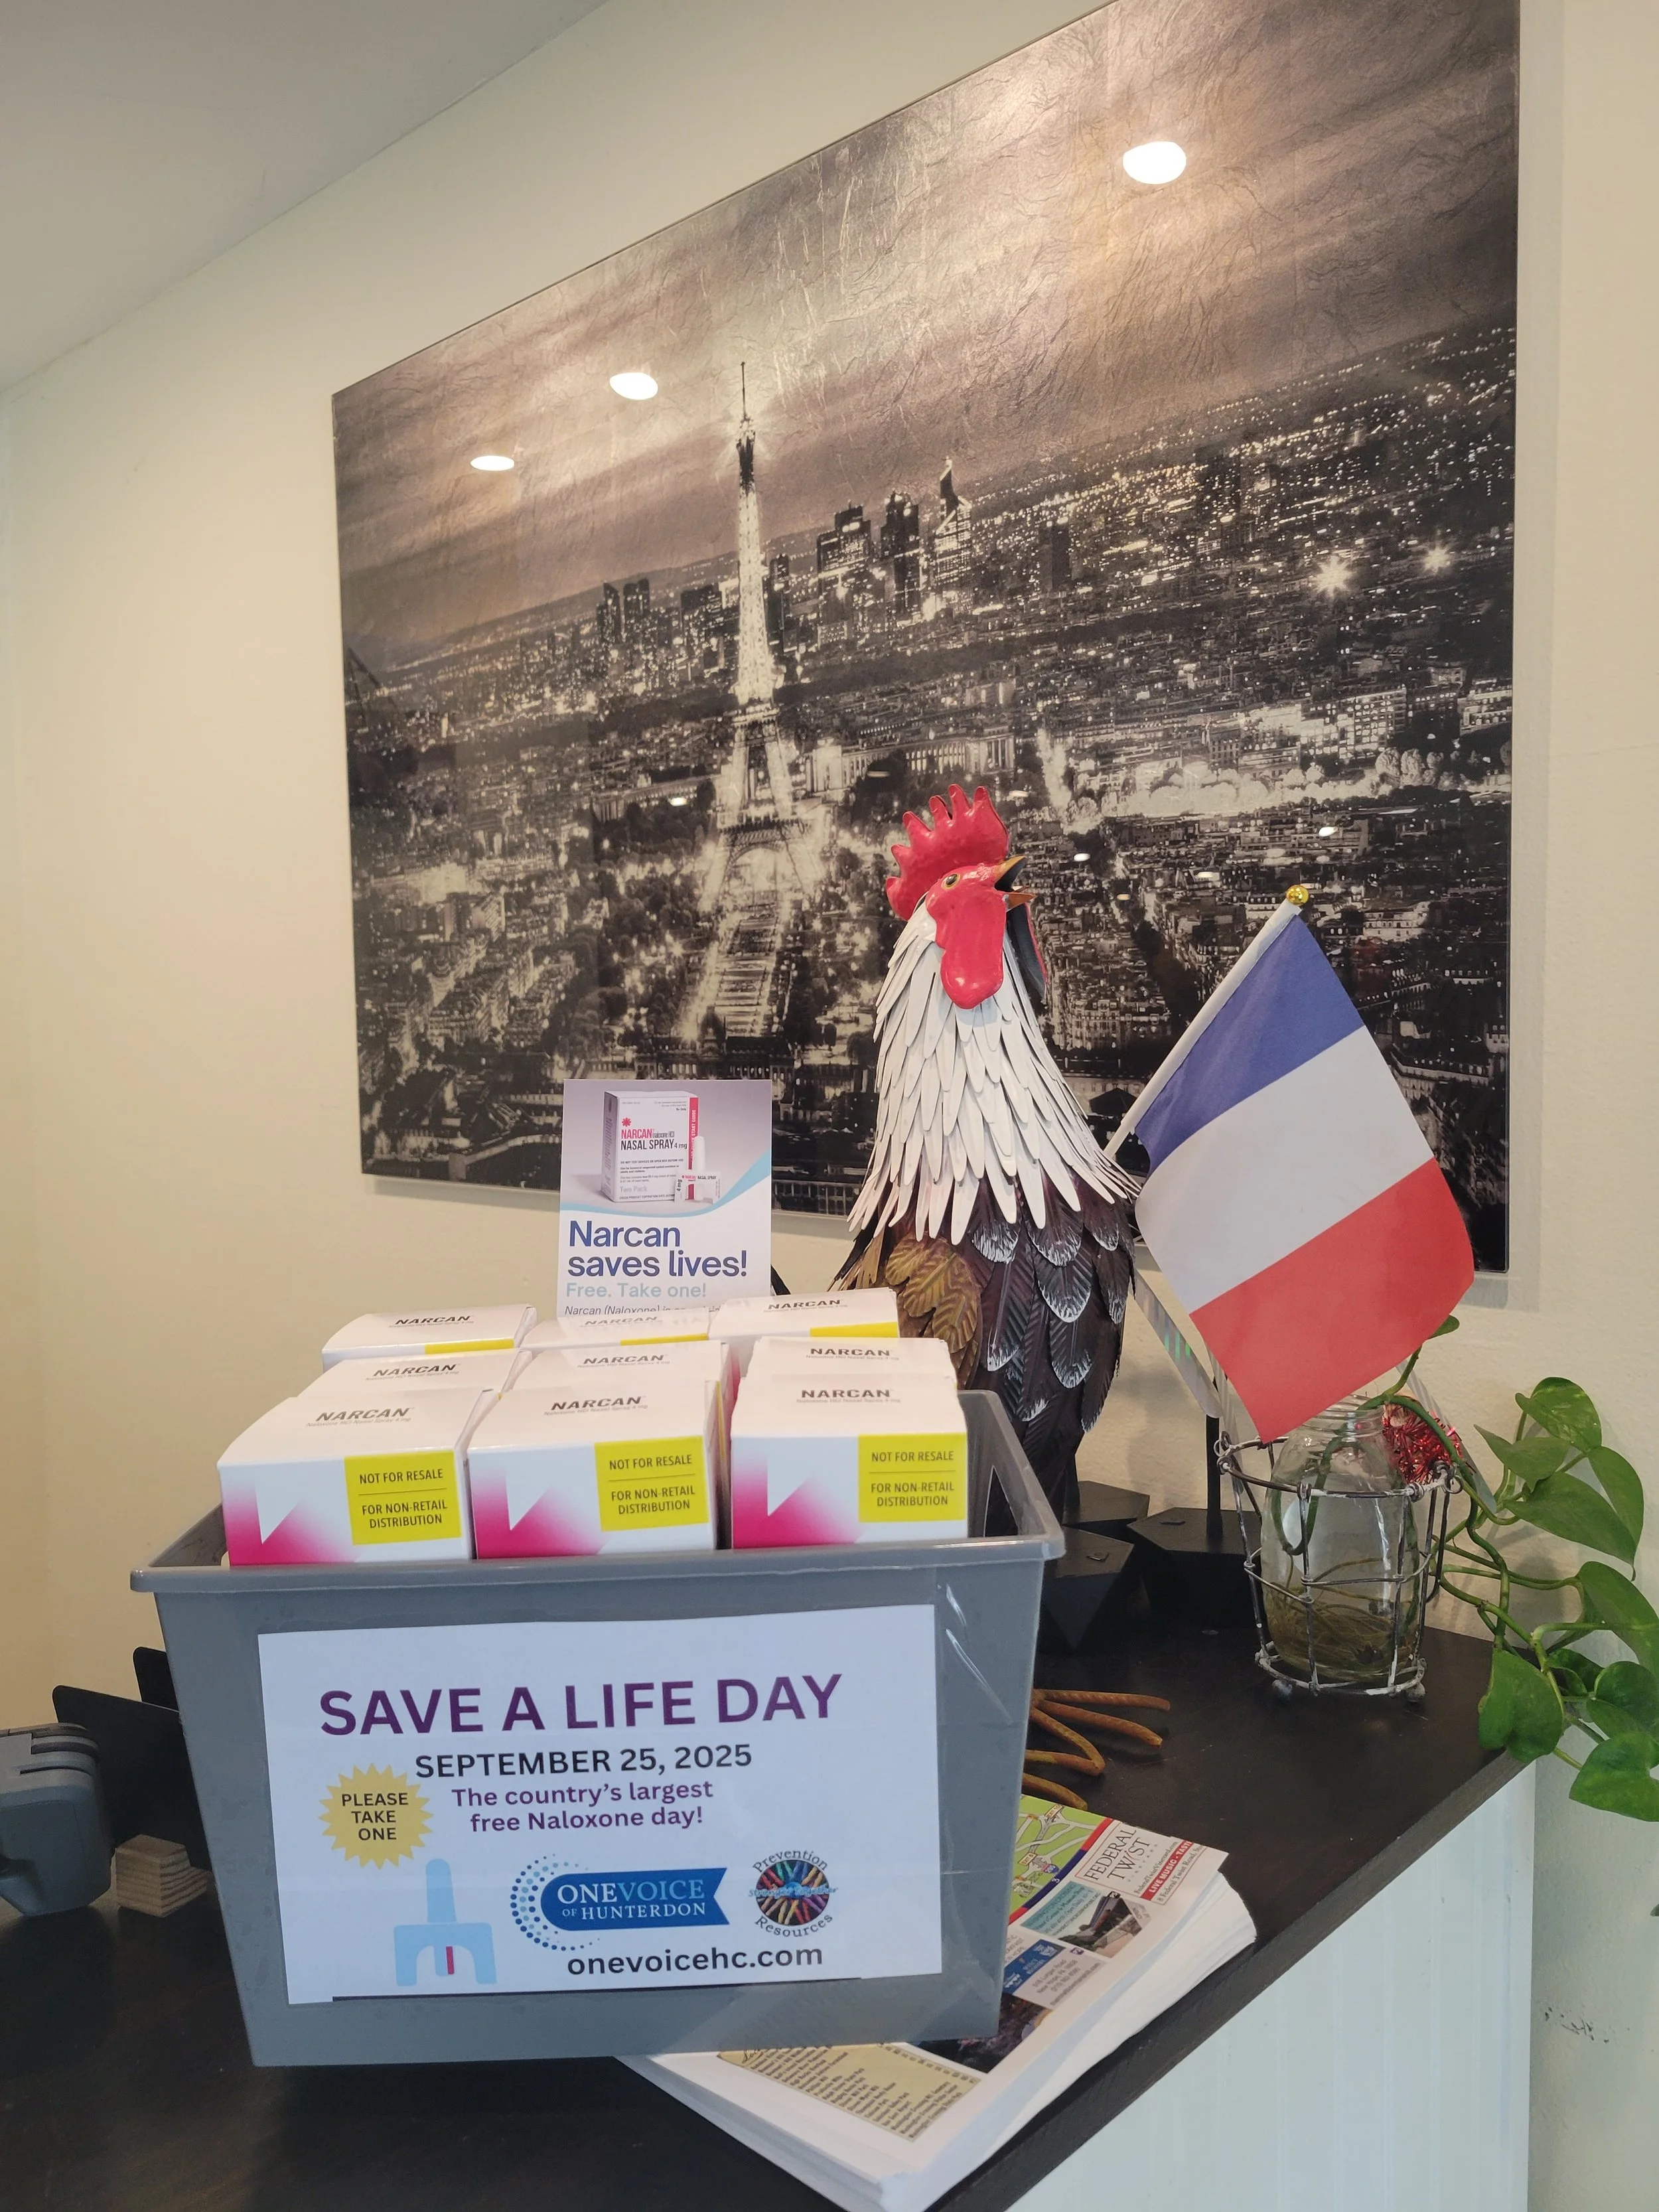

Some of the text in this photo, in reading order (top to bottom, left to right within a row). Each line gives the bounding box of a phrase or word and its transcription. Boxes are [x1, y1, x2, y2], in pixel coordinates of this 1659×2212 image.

[621, 1129, 652, 1140] NARCAN
[621, 1140, 647, 1151] NASAL
[649, 1139, 674, 1149] SPRAY
[569, 1220, 681, 1248] Narcan
[567, 1250, 747, 1277] saves lives!
[566, 1282, 706, 1297] Free. Take one!
[565, 1305, 601, 1315] Narcan
[768, 1300, 840, 1309] NARCAN
[395, 1316, 470, 1325] NARCAN
[584, 1355, 664, 1364] NARCAN
[373, 1364, 457, 1376] NARCAN
[551, 1396, 641, 1410] NARCAN
[315, 1408, 409, 1422] NARCAN
[609, 1454, 692, 1470] NOT FOR RESALE
[871, 1451, 954, 1462] NOT FOR RESALE
[360, 1469, 443, 1484] NOT FOR RESALE
[611, 1485, 695, 1501] FOR NON-RETAIL
[871, 1481, 954, 1493] FOR NON-RETAIL
[362, 1499, 448, 1515] FOR NON-RETAIL
[618, 1499, 690, 1514] DISTRIBUTION
[877, 1495, 948, 1507] DISTRIBUTION
[370, 1514, 442, 1528] DISTRIBUTION
[320, 1673, 842, 1735] SAVE A LIFE DAY
[415, 1743, 752, 1778] SEPTEMBER 25, 2025
[342, 1792, 409, 1806] PLEASE
[451, 1781, 713, 1808] The country’s largest
[351, 1810, 396, 1824] TAKE
[470, 1806, 703, 1832] free Naloxone day!
[358, 1827, 397, 1841] ONE
[752, 1849, 828, 1873] Prevention
[1084, 1828, 1137, 1881] FEDERAL
[1149, 1880, 1162, 1893] LIVE
[1161, 1859, 1177, 1880] MUSIC
[557, 1879, 705, 1905] ONEVOICE
[562, 1901, 706, 1920] OF HUNTERDON
[755, 1914, 833, 1937] Resources
[567, 1947, 823, 1975] onevoicehc.com
